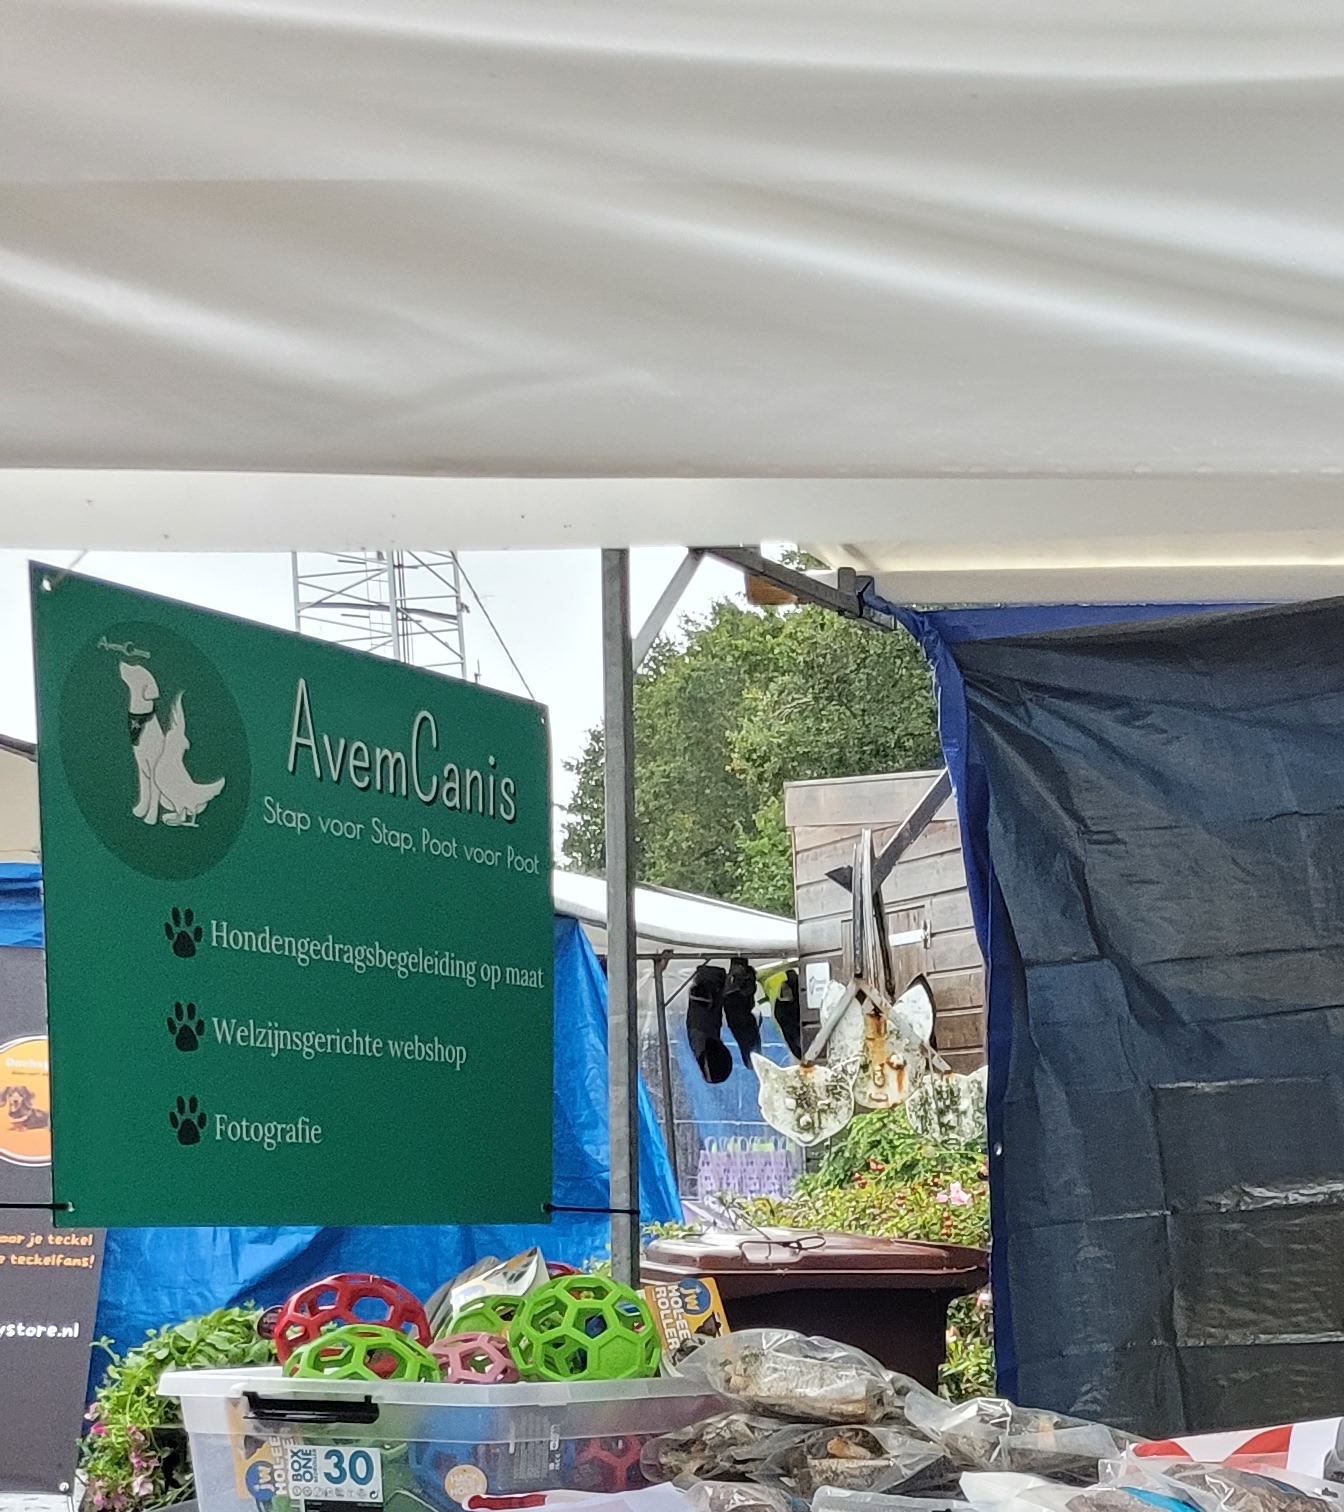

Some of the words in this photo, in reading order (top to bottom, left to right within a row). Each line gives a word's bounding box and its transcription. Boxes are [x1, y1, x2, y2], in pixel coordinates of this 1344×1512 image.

[287, 677, 517, 823] AvemCanis
[263, 796, 311, 835] Stap
[318, 815, 365, 840] voor
[422, 827, 459, 859] Poot
[463, 844, 502, 867] voor
[507, 846, 540, 875] Poot
[210, 919, 477, 987] Hondengedragsbegeleiding
[480, 961, 502, 990] op
[505, 964, 545, 989] maat
[212, 1017, 383, 1060] Welzijnsgerichte
[387, 1034, 467, 1071] webshop
[214, 1113, 322, 1151] Fotografie
[26, 1232, 44, 1249] je
[47, 1233, 94, 1246] teckel
[10, 1253, 95, 1269] teckelfans!
[655, 1286, 681, 1350] ROLLER
[290, 1447, 303, 1482] BOX
[301, 1448, 314, 1483] ONE
[323, 1449, 375, 1486] 30
